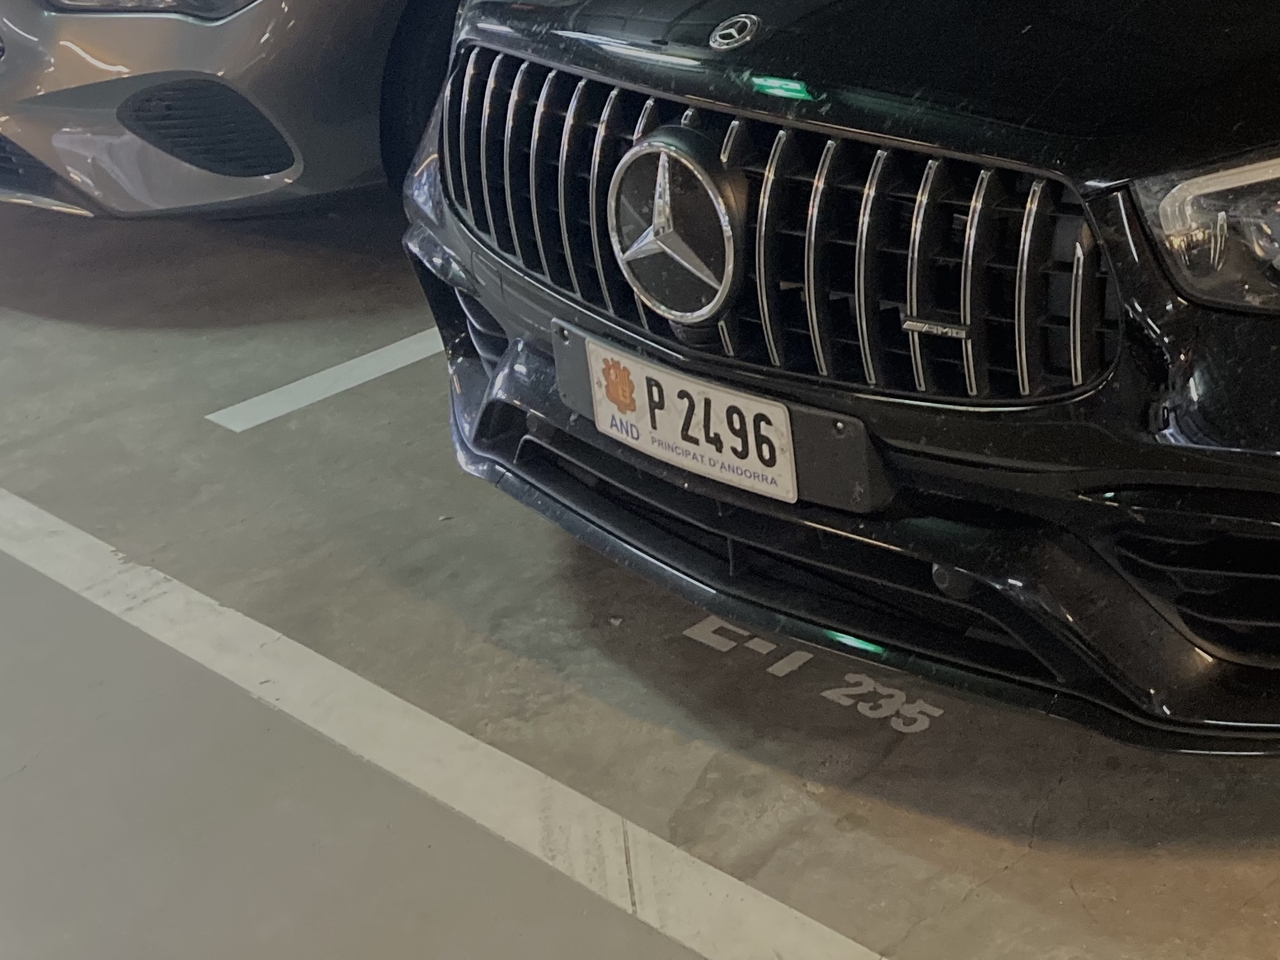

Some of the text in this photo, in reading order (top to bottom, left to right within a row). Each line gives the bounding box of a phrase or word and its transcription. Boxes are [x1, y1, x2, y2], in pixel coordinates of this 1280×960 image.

[610, 414, 640, 441] AND
[645, 376, 777, 468] P 2496
[651, 436, 778, 487] PRINCIPAT D'ANDORRA
[820, 673, 944, 733] 235
